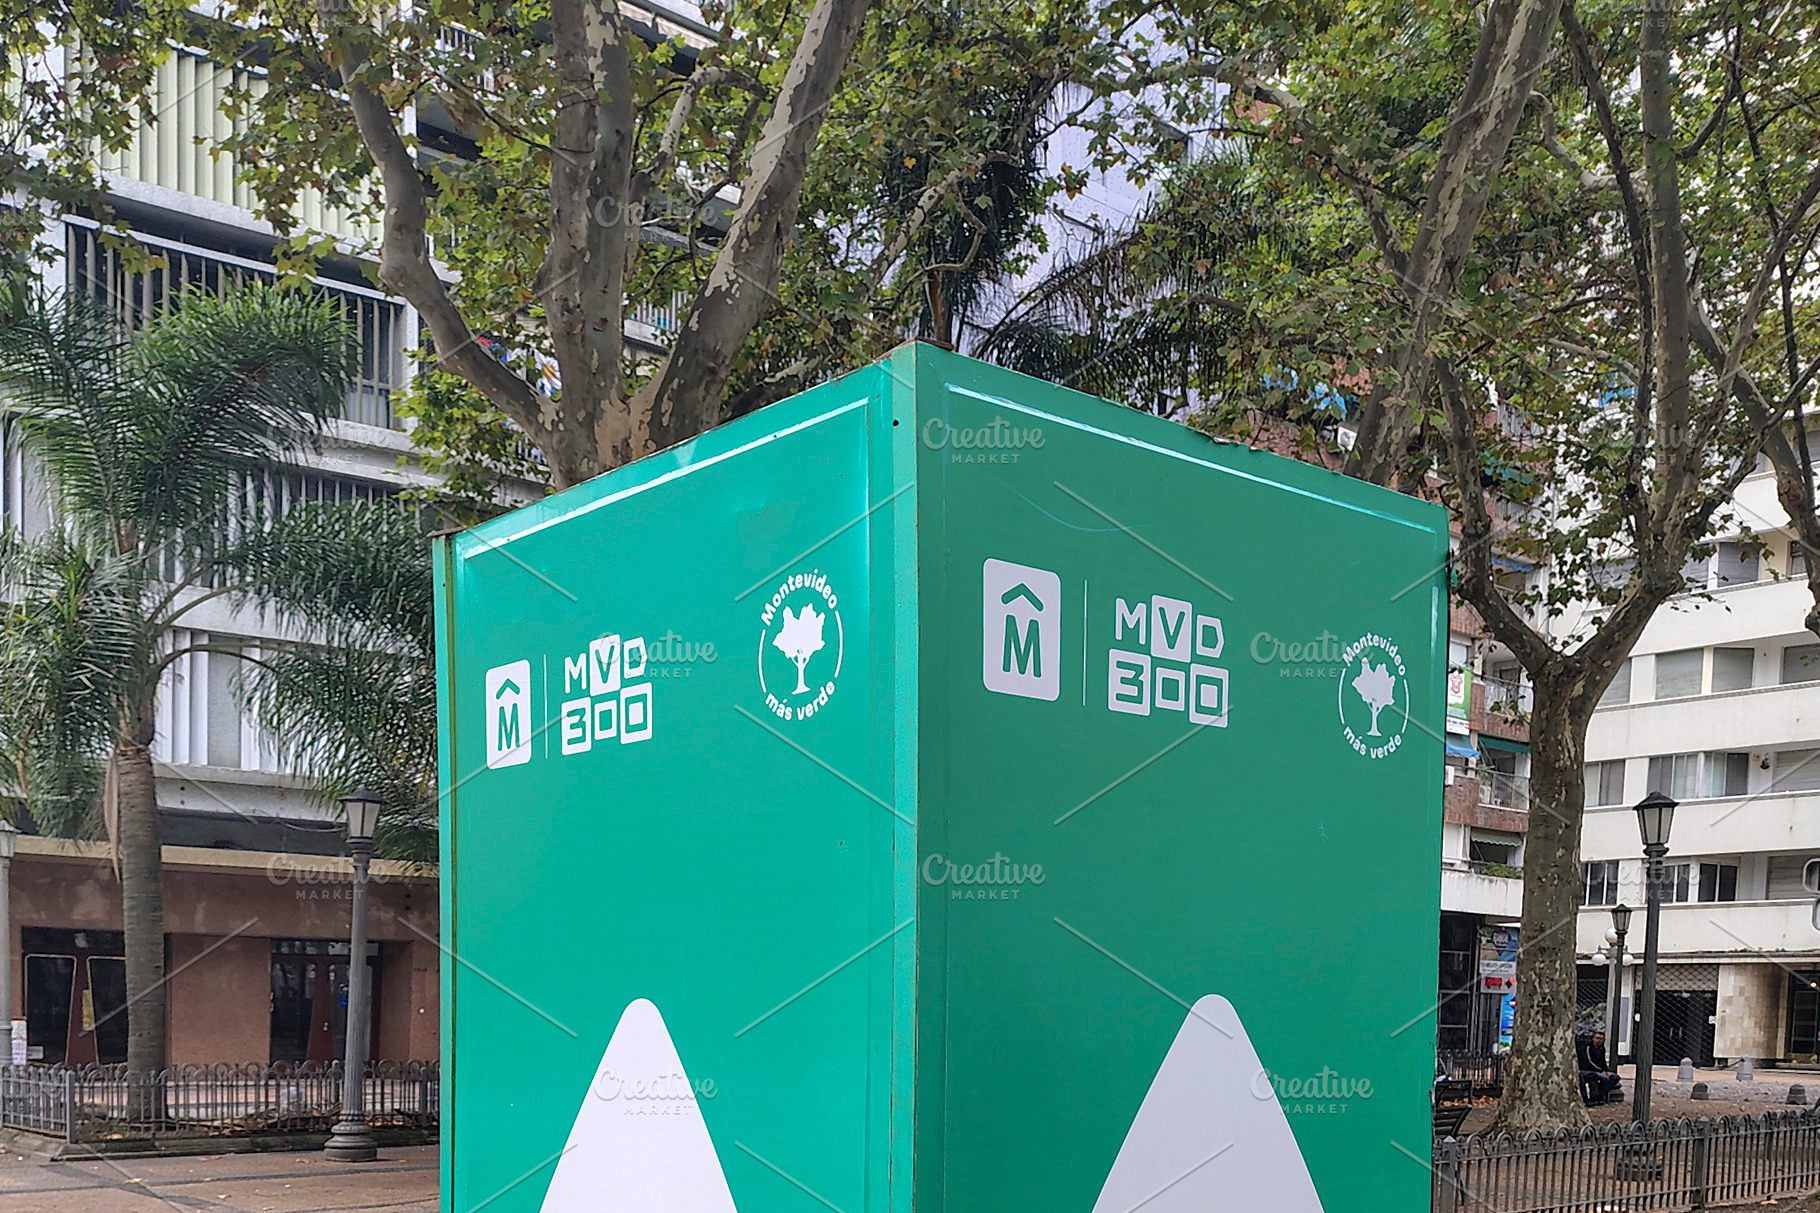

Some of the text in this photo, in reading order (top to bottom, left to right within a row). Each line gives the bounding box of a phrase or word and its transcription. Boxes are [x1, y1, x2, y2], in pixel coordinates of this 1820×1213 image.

[761, 568, 837, 626] Montevideo
[1115, 595, 1225, 660] MVD
[1343, 632, 1406, 667] Montevideo
[564, 635, 648, 694] MVD
[1109, 649, 1229, 728] 300
[561, 682, 653, 756] 300
[765, 681, 835, 721] más verde
[1344, 726, 1402, 759] más verde
